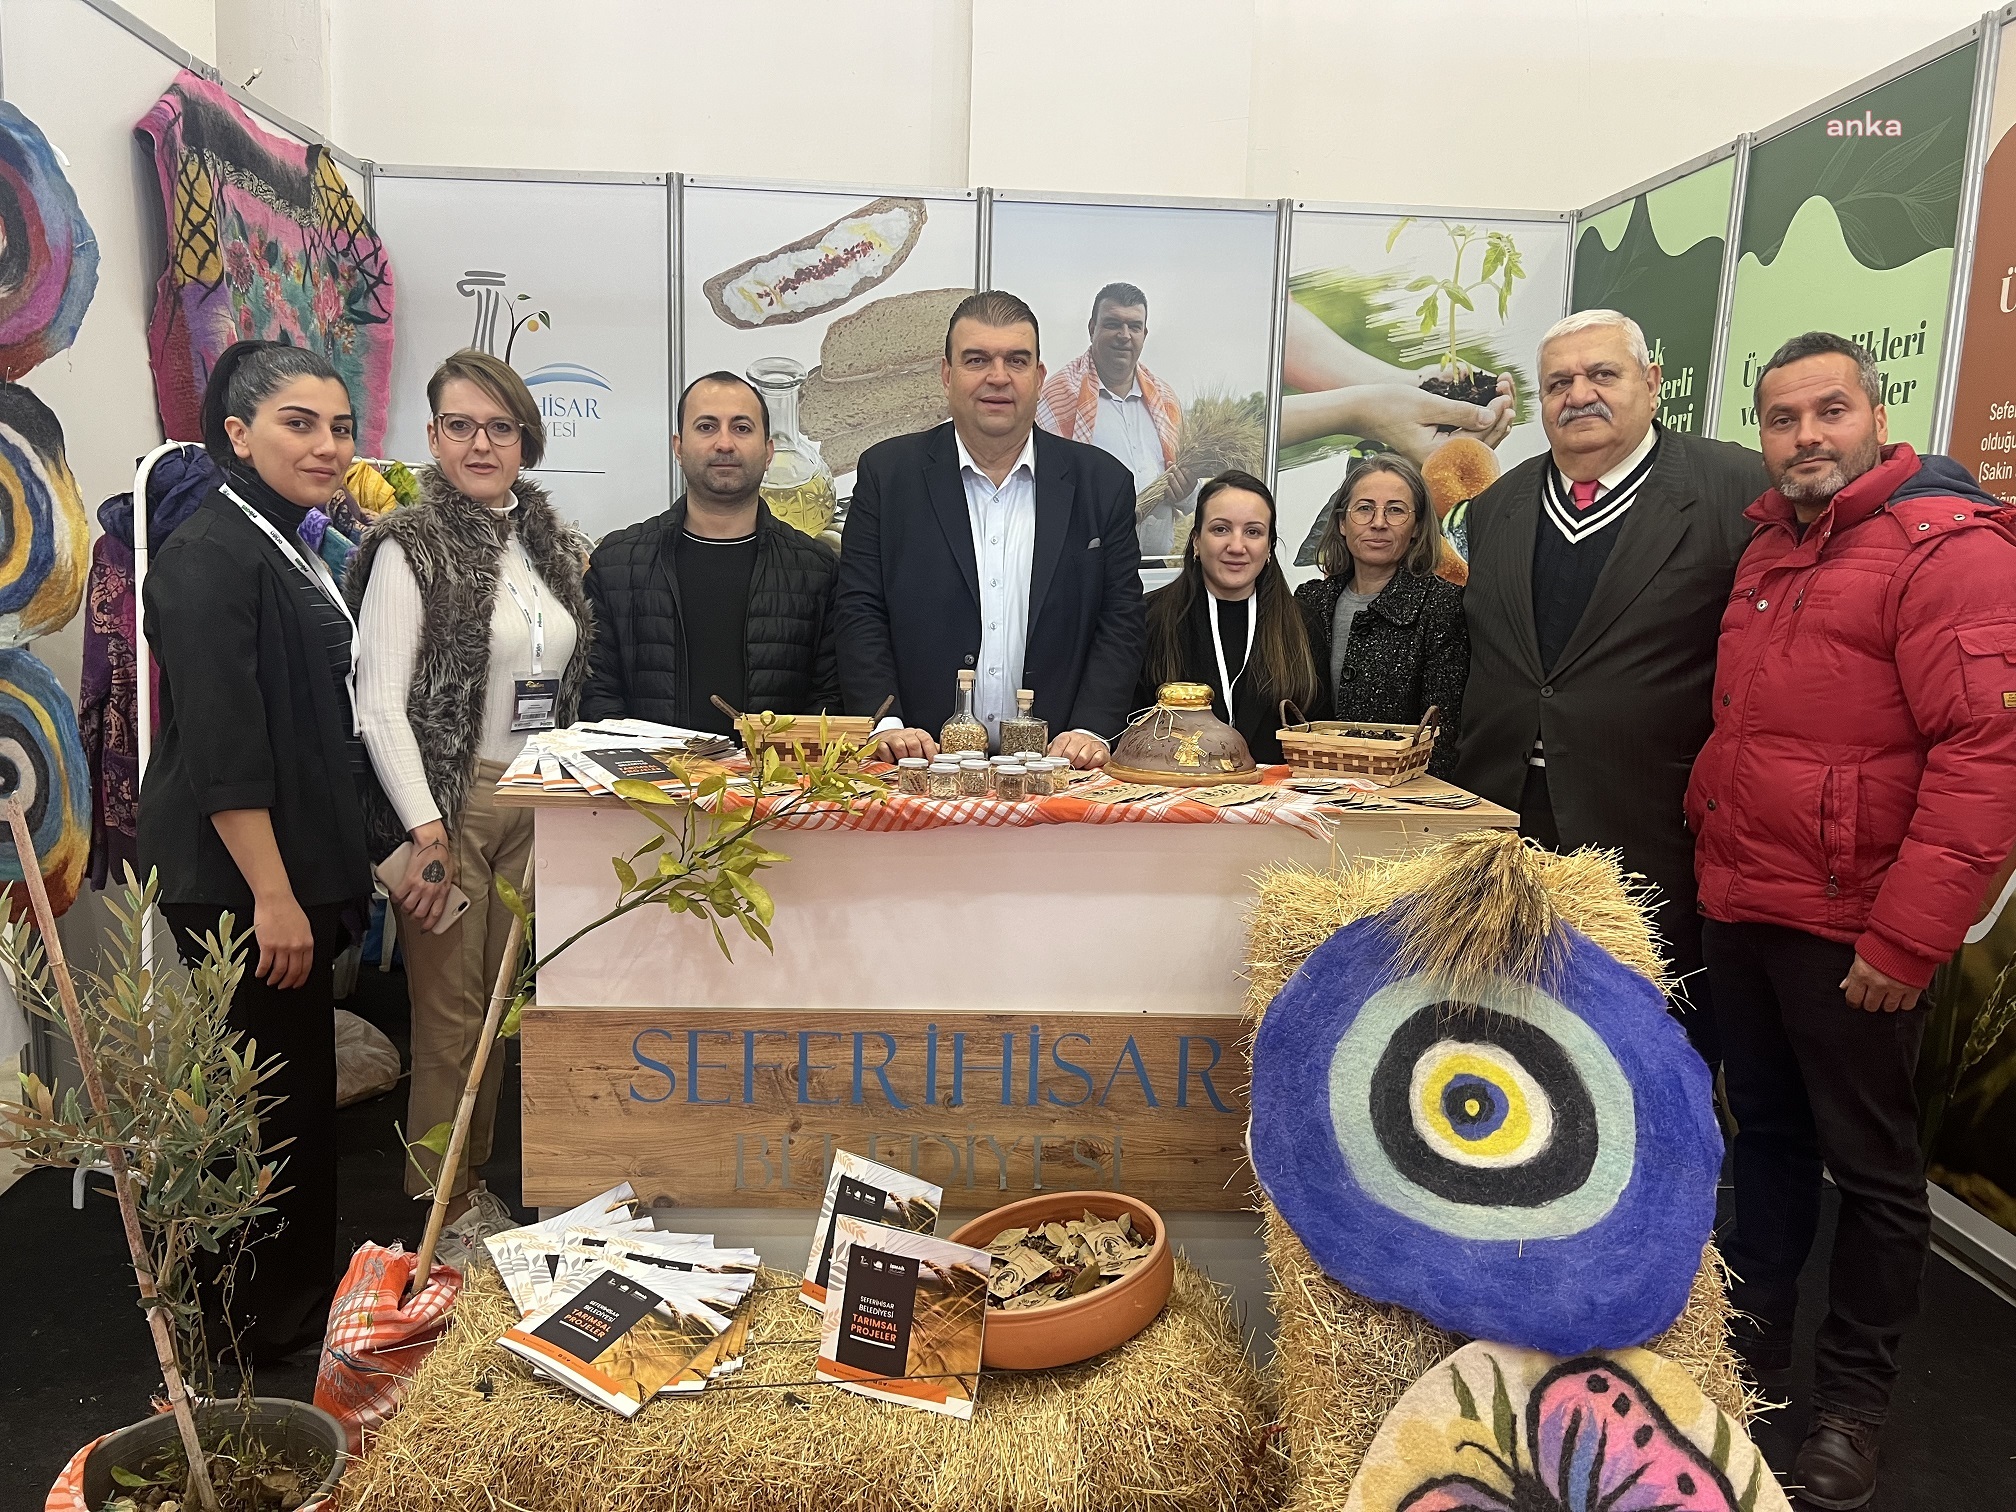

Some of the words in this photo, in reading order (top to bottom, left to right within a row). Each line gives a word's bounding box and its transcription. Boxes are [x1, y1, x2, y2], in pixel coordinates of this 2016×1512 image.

[541, 394, 601, 419] HİSAR
[1990, 400, 2016, 421] Sefe
[543, 419, 576, 438] YESİ
[1979, 461, 2013, 483] (Sakin
[629, 1023, 1236, 1113] SEFERİHİSAR
[571, 1309, 612, 1332] TARIMSAL
[859, 1304, 894, 1318] BELEDİYESİ
[564, 1314, 606, 1338] PROJELER
[850, 1324, 897, 1342] PROJELER
[852, 1313, 898, 1332] TARIMSAL
